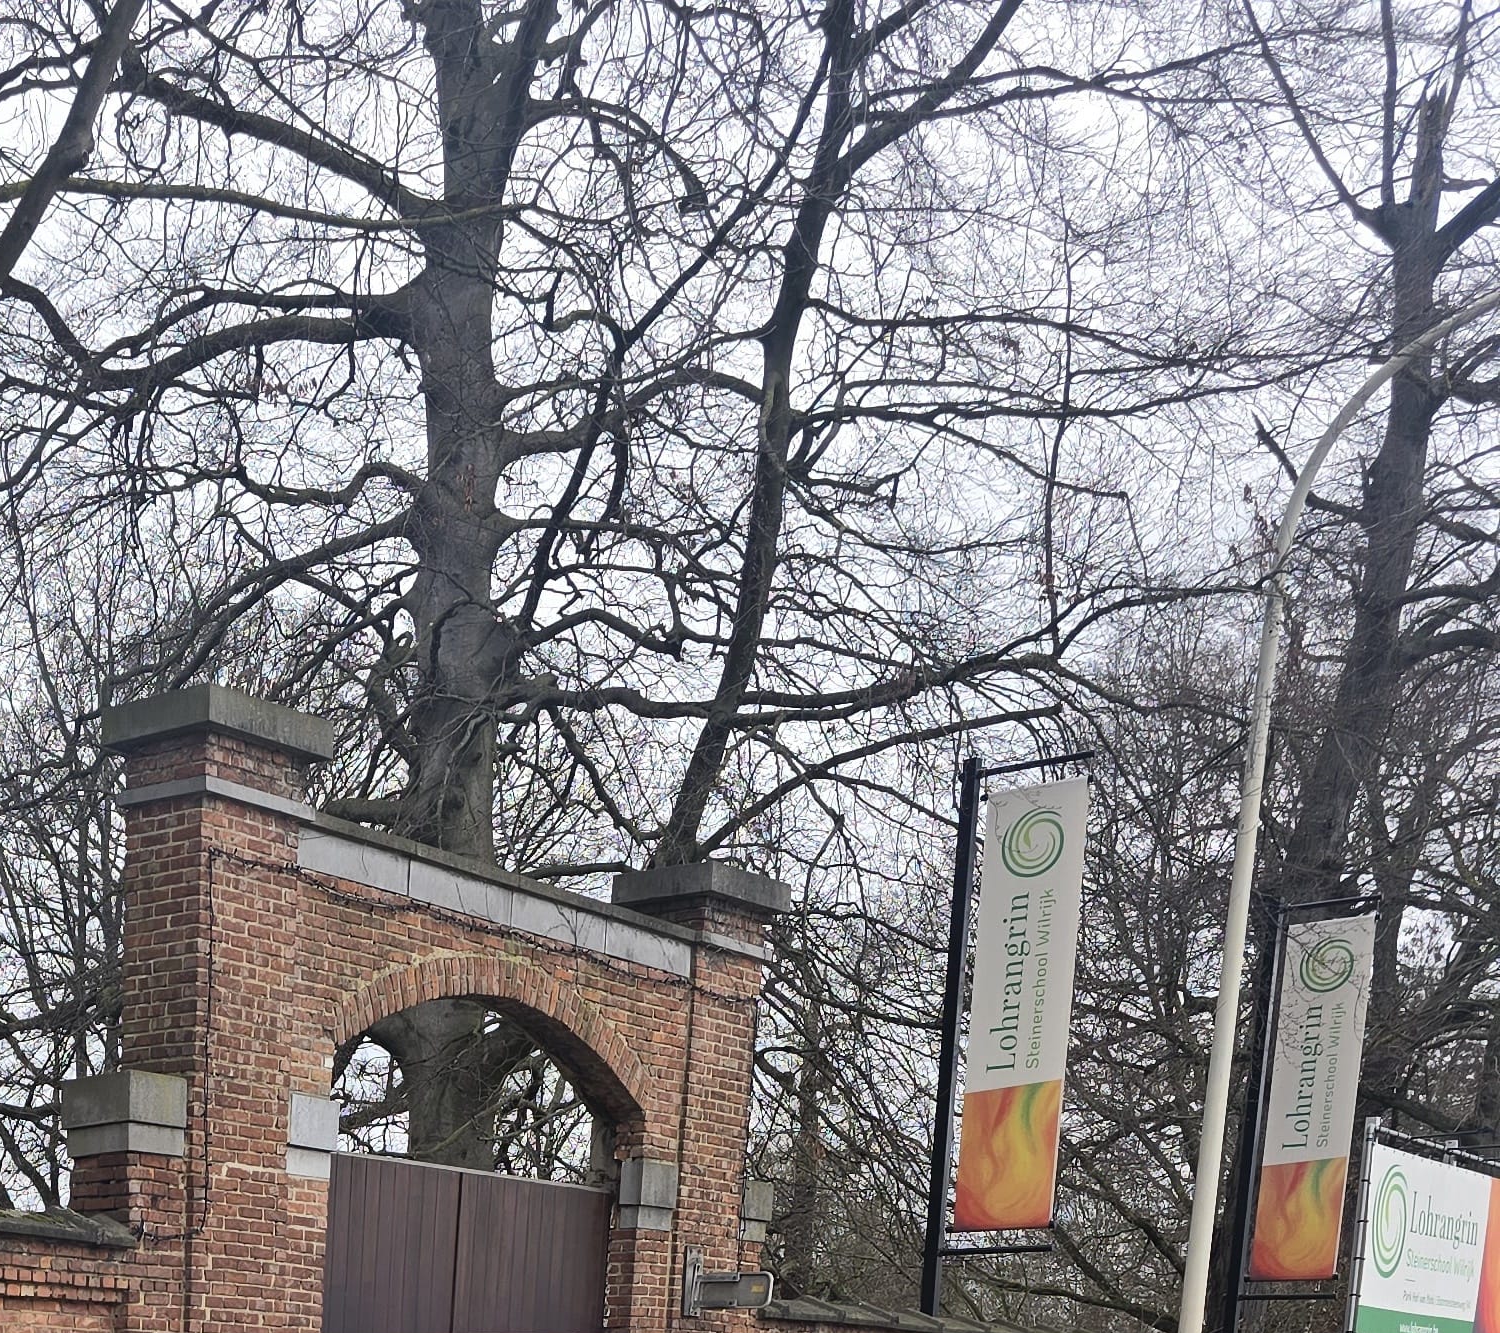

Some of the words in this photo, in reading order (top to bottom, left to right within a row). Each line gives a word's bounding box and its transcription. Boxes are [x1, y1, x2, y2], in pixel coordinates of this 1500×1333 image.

[1036, 887, 1057, 947] Wilrijk
[985, 890, 1031, 1074] Lohrangrin
[1025, 952, 1049, 1070] Steinerschool
[1281, 1003, 1324, 1151] Lohrangrin
[1316, 1053, 1338, 1149] Steinerschool
[1328, 1001, 1347, 1049] Wilrijk
[1405, 1248, 1452, 1275] Steinerschool
[1409, 1190, 1479, 1250] Lohrangrin
